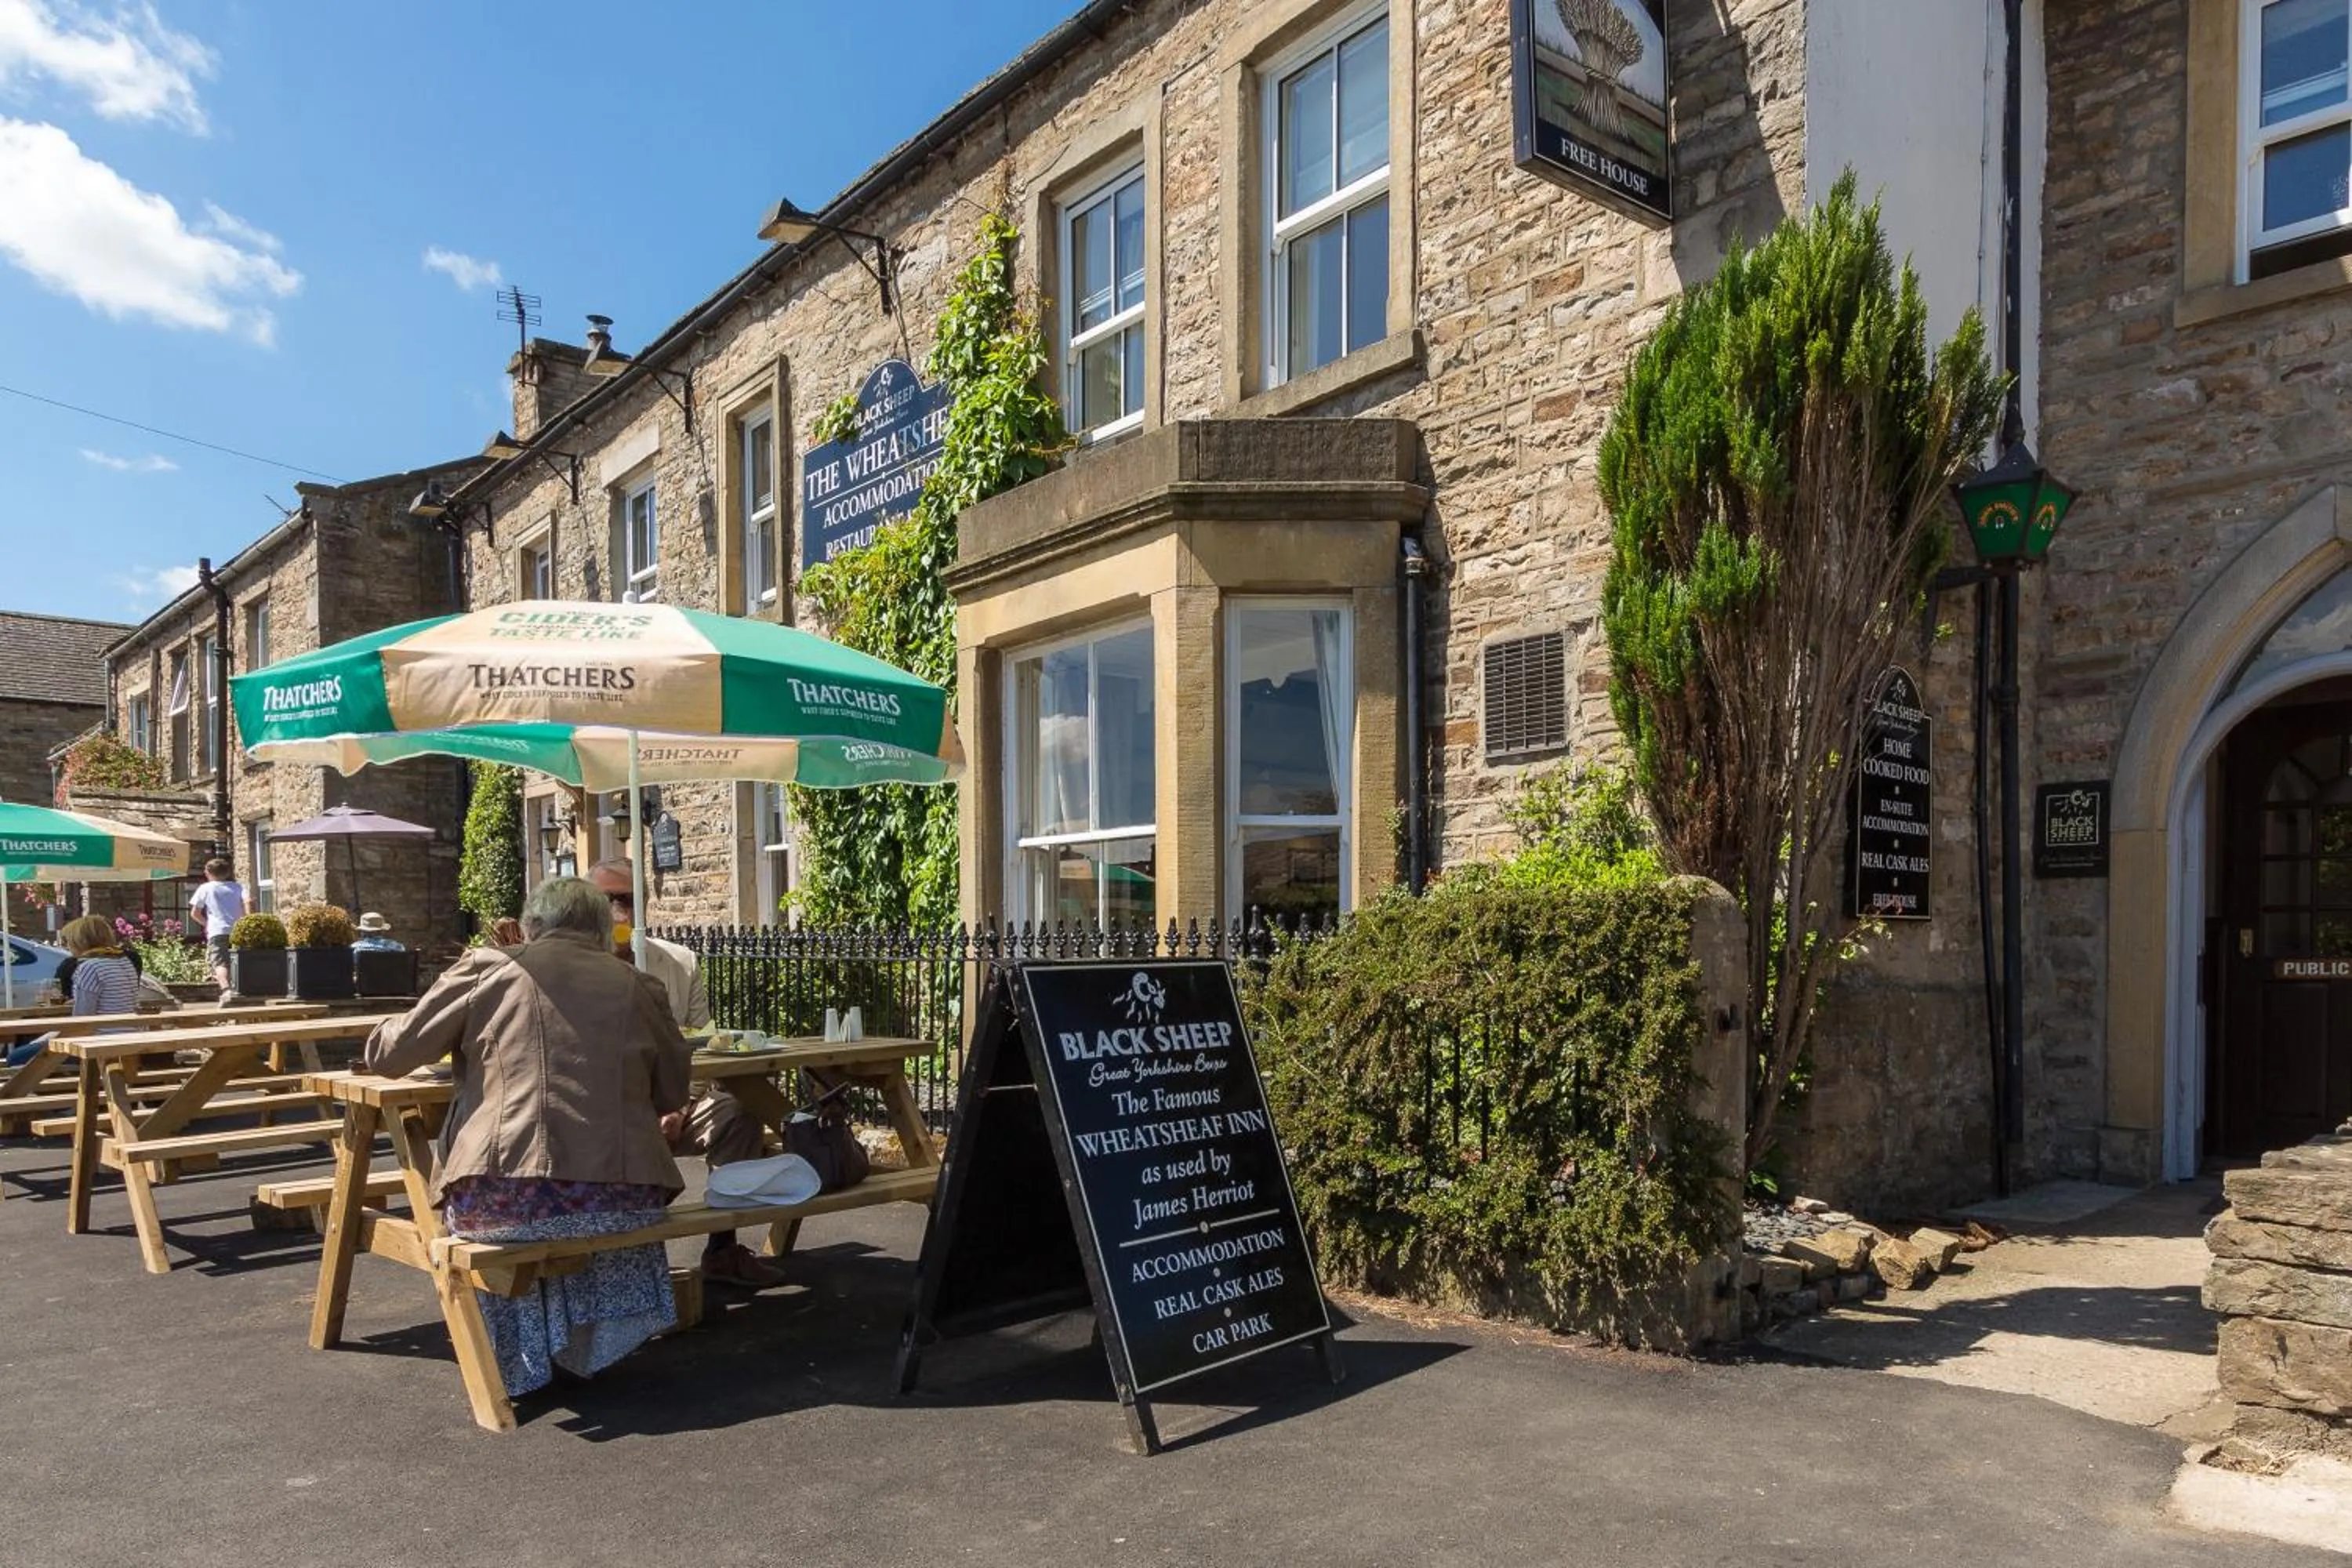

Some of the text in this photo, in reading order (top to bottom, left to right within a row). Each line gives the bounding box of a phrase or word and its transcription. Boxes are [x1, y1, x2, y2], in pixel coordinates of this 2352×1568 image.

[1561, 137, 1649, 195] FREE HOUSE
[884, 385, 915, 413] SHEEP
[806, 460, 840, 502] THE
[845, 406, 949, 483] WHEATSHE
[823, 459, 939, 529] ACCOMMODATIO
[499, 612, 653, 626] CIDER'S
[263, 674, 343, 711] THATCHERS
[467, 664, 636, 689] THATCHERS
[786, 677, 902, 717] THATCHERS
[1884, 737, 1912, 760] HOME
[1864, 758, 1929, 785] COOKED FOOD
[2050, 815, 2094, 828] BLACK
[2050, 826, 2094, 838] SHEEP
[0, 838, 78, 852] THATCHERS
[1861, 851, 1929, 873] REAL CASK ALES
[2283, 962, 2350, 975] PUBLIC
[1059, 1021, 1232, 1061] BLACK SHEEP
[1089, 1062, 1131, 1087] Great
[1131, 1058, 1192, 1083] Yorkshire
[1112, 1087, 1221, 1117] The Famous
[1075, 1109, 1269, 1159] WHEATSHEAF INN
[1141, 1149, 1232, 1185] as used by
[1132, 1180, 1256, 1230] James Herriot
[1131, 1229, 1287, 1283] ACCOMMODATION
[1153, 1267, 1285, 1320] REAL CASK ALES
[1192, 1313, 1274, 1356] CAR PARK
